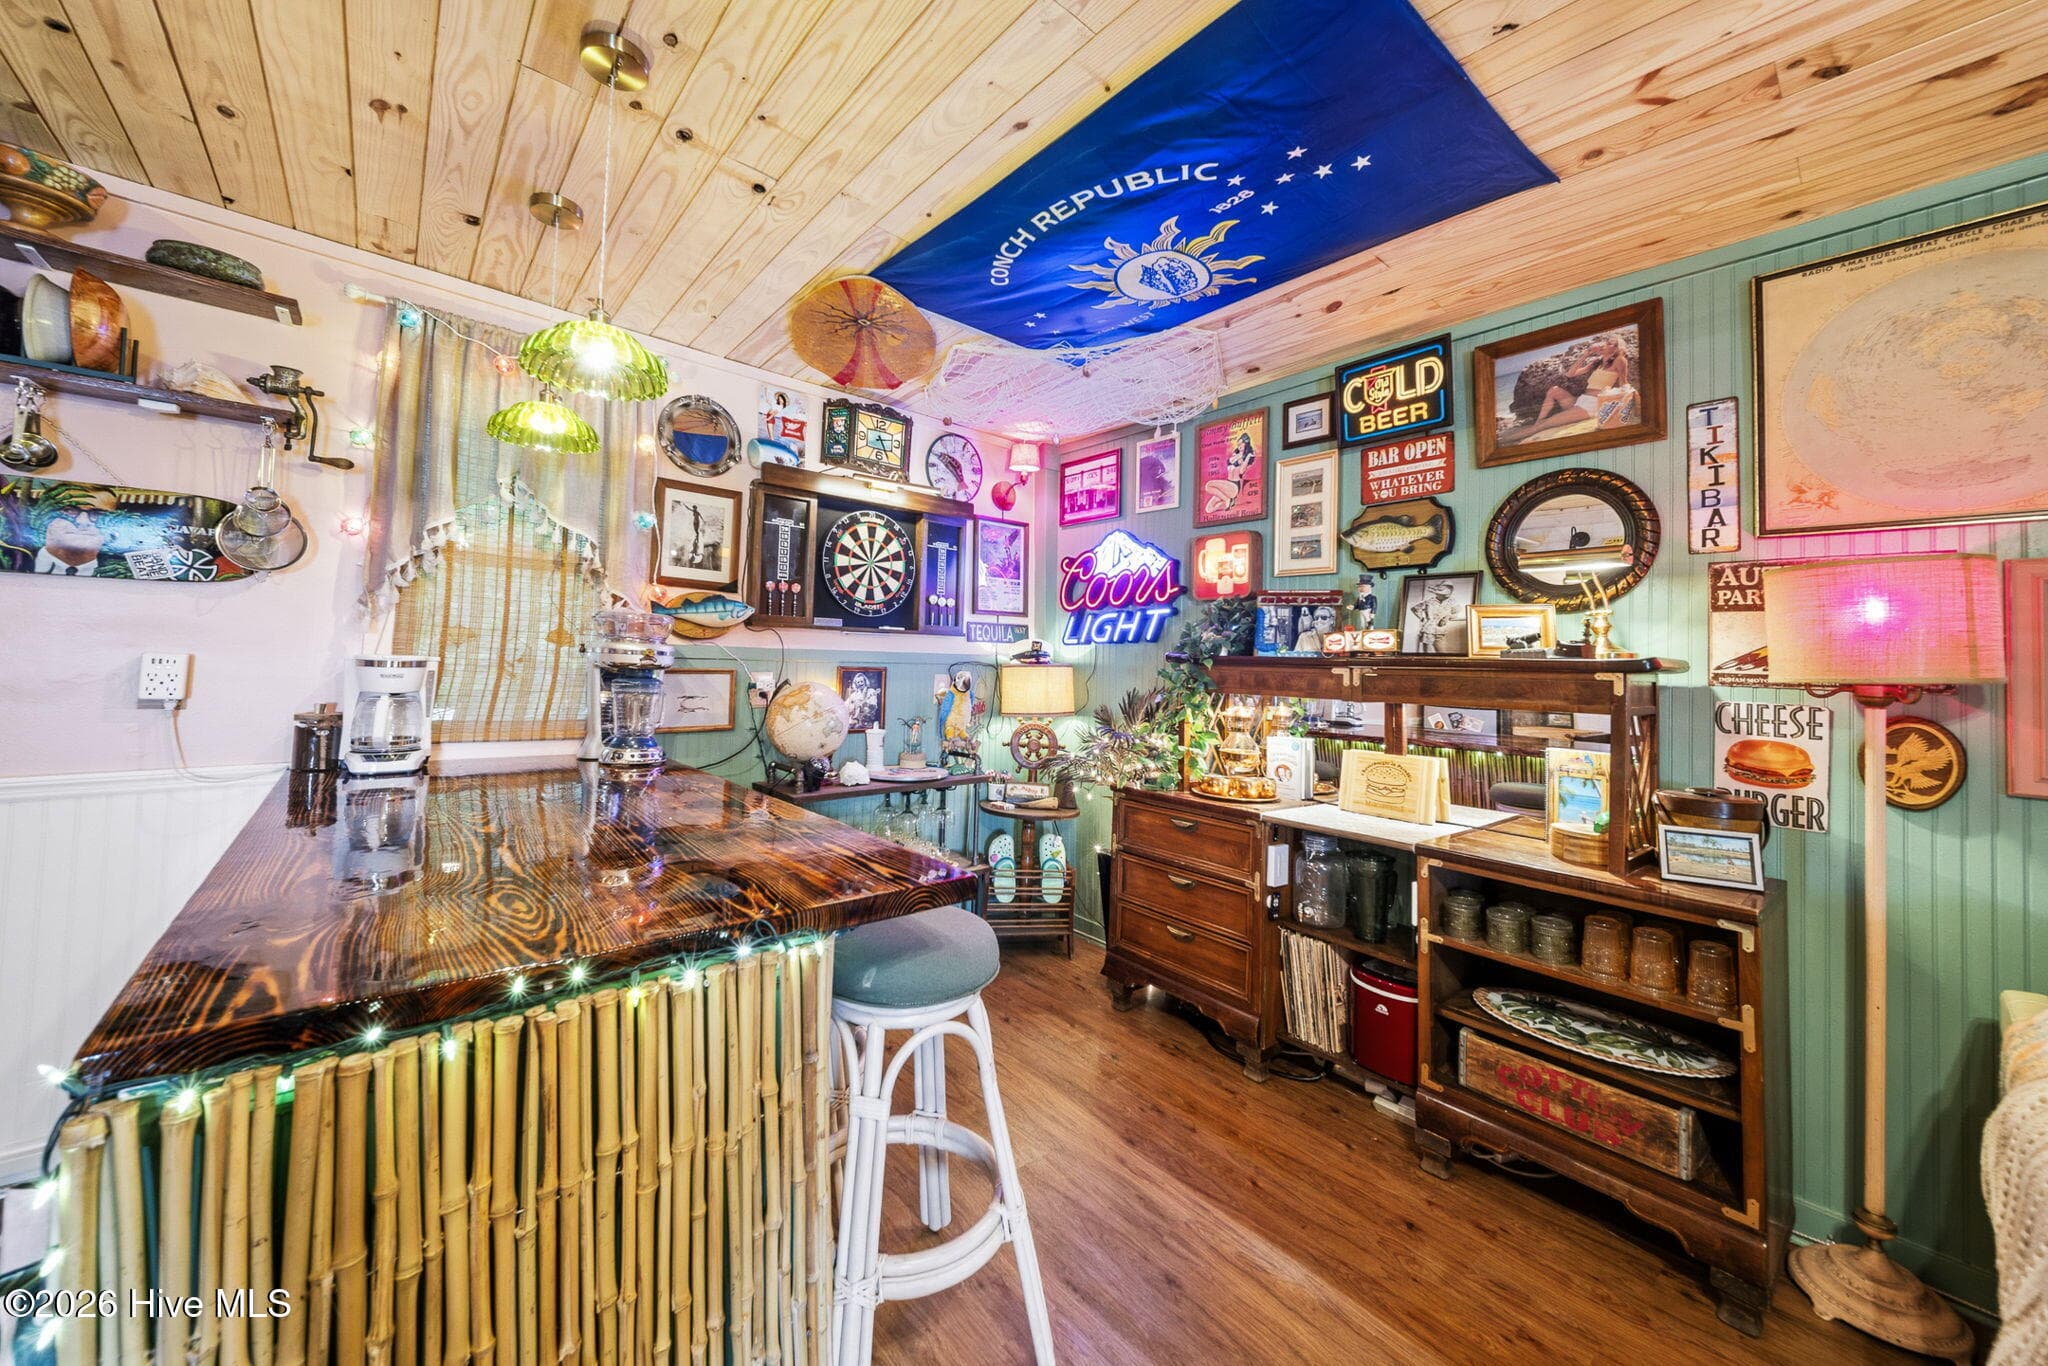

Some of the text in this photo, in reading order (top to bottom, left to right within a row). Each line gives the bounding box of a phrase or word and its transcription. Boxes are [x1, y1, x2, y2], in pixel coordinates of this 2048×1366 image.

[1208, 189, 1255, 215] 1828
[990, 162, 1220, 287] CONCH REPUBLIC
[1801, 265, 1833, 278] RADIO
[1839, 249, 1897, 268] AMATEURS
[1903, 238, 1939, 253] GREAT
[1945, 228, 1984, 242] CIRCLE
[1992, 215, 2033, 231] CHART
[1342, 355, 1445, 415] COLD
[876, 419, 887, 429] 12
[1358, 401, 1429, 434] BEER
[858, 431, 867, 441] 9
[893, 440, 901, 449] 3
[875, 451, 884, 461] 6
[1367, 446, 1400, 469] BAR
[1403, 435, 1448, 462] OPEN
[1369, 469, 1446, 492] WHATEVER
[1372, 480, 1443, 501] YOU BRING
[1060, 550, 1182, 612] Coors
[1716, 566, 1764, 587] AU
[1716, 589, 1764, 605] PAR
[969, 624, 1014, 642] TEQUILA
[1062, 608, 1172, 644] LIGHT
[1718, 676, 1746, 684] INDIAN
[1714, 701, 1825, 741] CHEESE
[1515, 1088, 1623, 1147] CLUB
